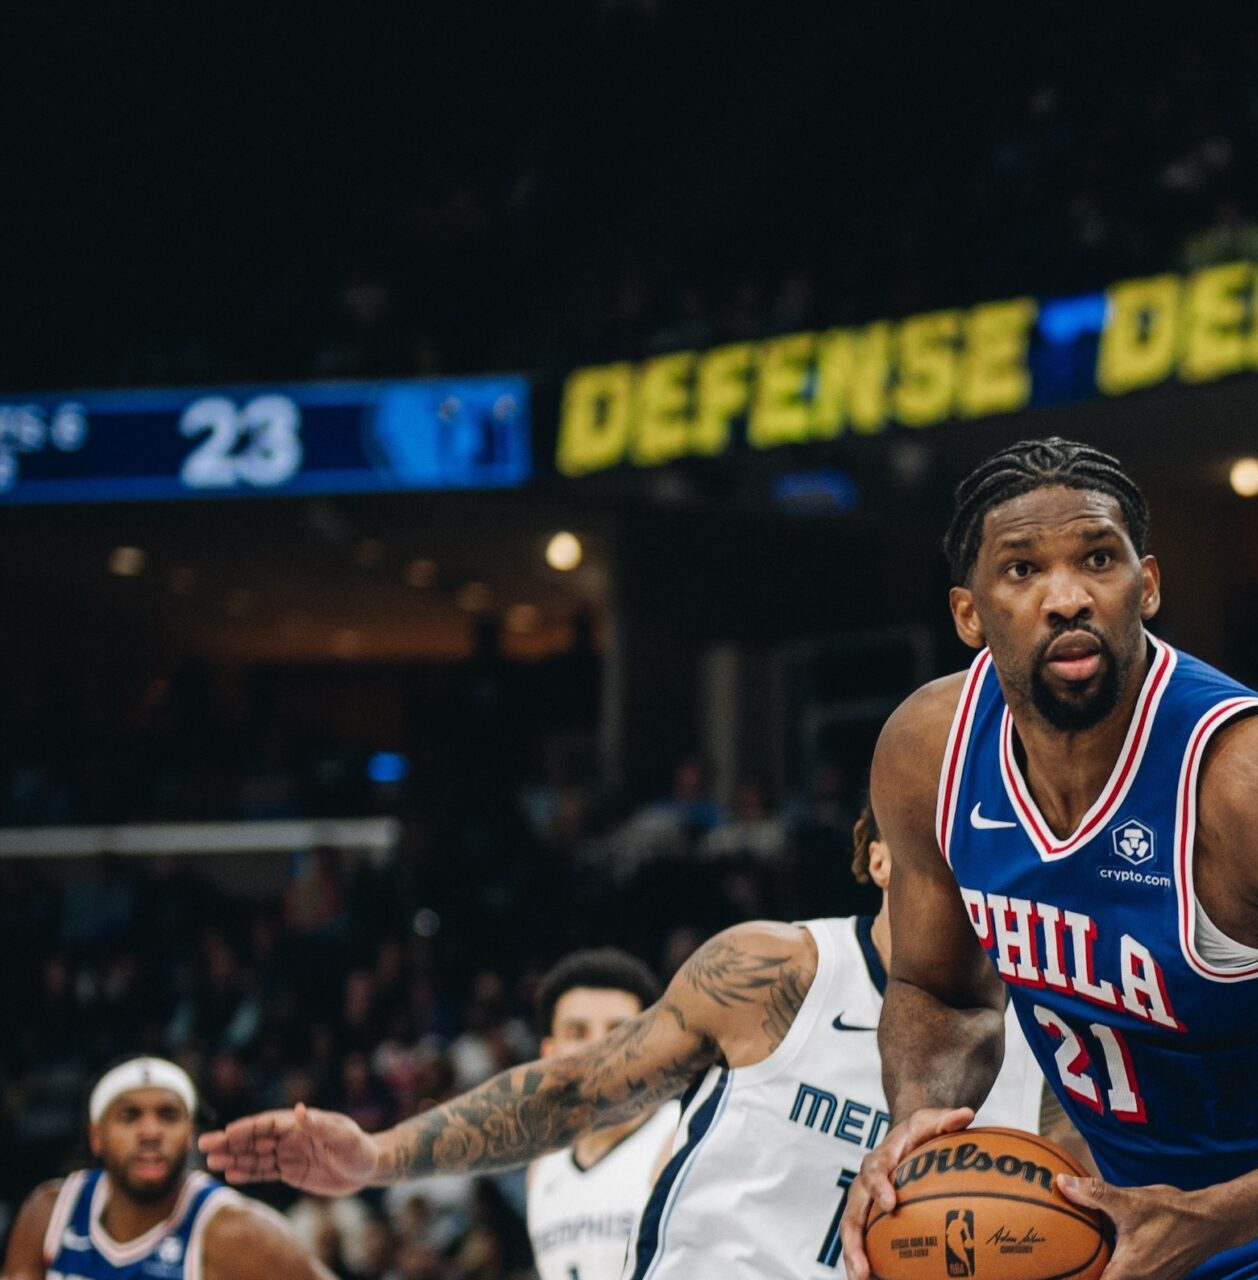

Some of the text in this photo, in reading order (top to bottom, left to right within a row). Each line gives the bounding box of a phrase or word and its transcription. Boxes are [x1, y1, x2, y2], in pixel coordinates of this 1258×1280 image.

[555, 296, 1038, 478] DEFENSE
[181, 395, 299, 489] 23
[1099, 868, 1172, 888] crypto.com
[960, 886, 1188, 1033] PHILA
[1033, 1004, 1147, 1124] 21
[895, 1143, 1053, 1193] Wilson
